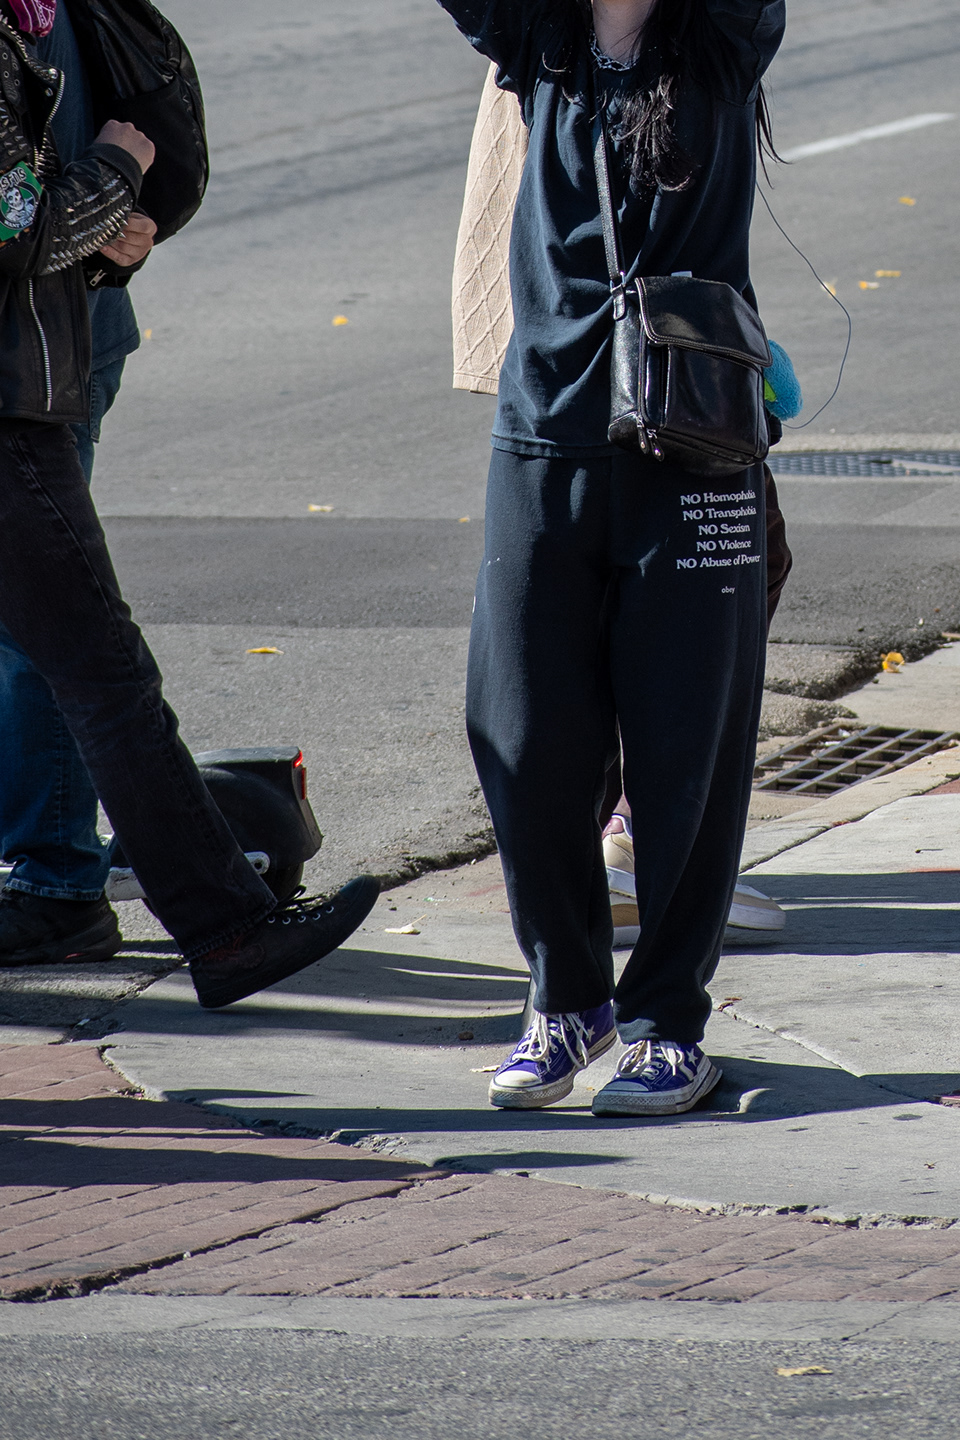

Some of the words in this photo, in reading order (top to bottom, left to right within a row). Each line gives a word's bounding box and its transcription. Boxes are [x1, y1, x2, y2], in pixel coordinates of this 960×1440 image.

[680, 493, 702, 506] NO
[682, 509, 704, 521] NO
[697, 524, 719, 536] NO
[720, 523, 751, 534] Sexism
[696, 540, 717, 552] NO
[718, 539, 752, 551] Violence
[676, 558, 698, 570] NO
[699, 557, 732, 568] Abuse
[732, 554, 741, 566] of
[740, 554, 761, 566] Power
[721, 585, 736, 594] obey
